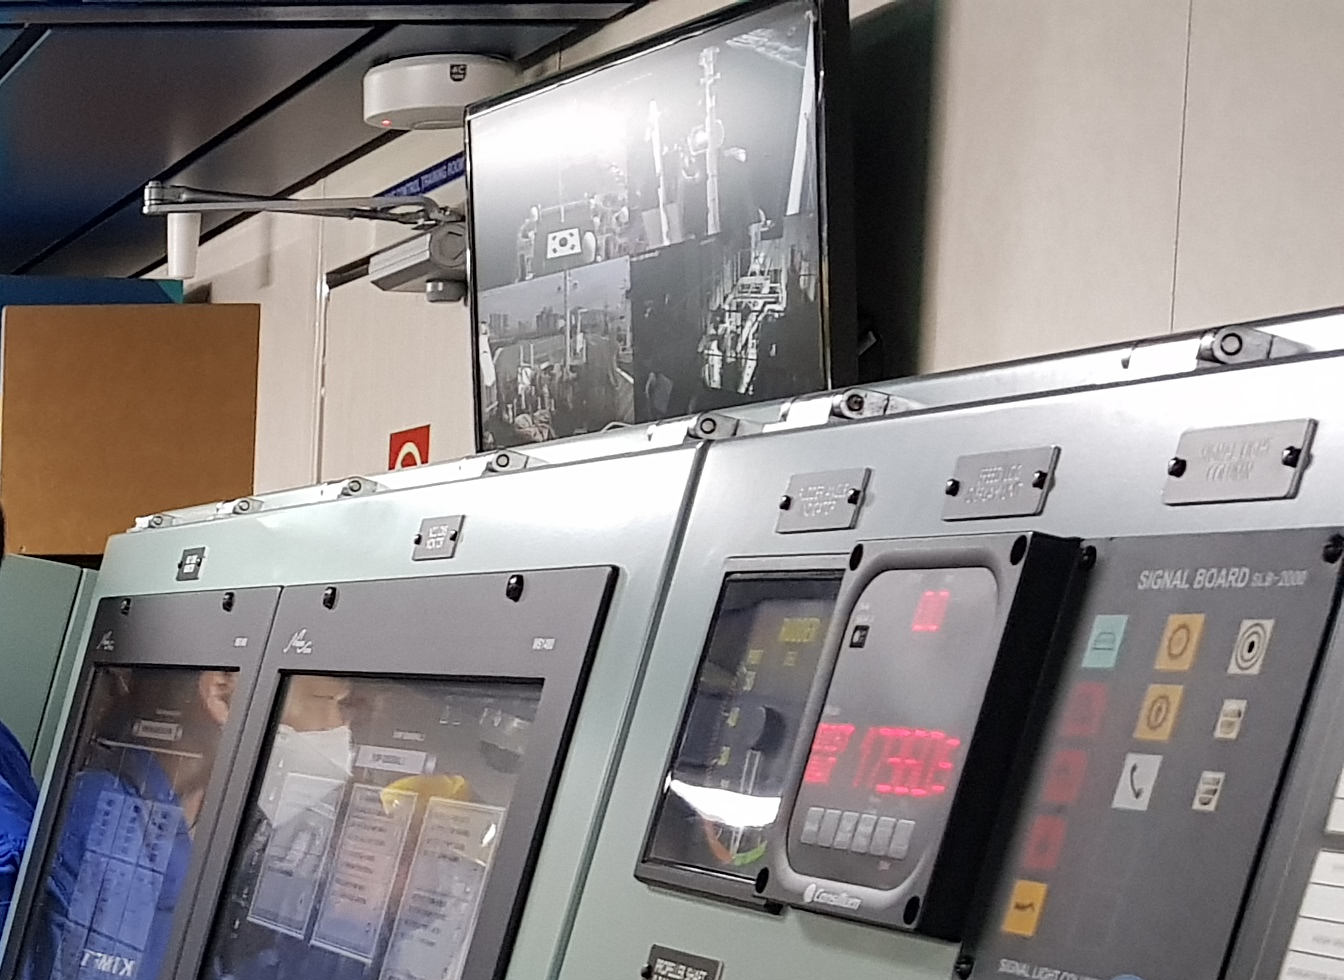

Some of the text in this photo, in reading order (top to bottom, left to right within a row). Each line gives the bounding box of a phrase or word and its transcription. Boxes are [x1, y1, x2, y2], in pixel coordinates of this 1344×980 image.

[1138, 569, 1189, 590] SIGNAL
[1193, 567, 1250, 589] BOARD
[998, 957, 1031, 978] SIGNAL
